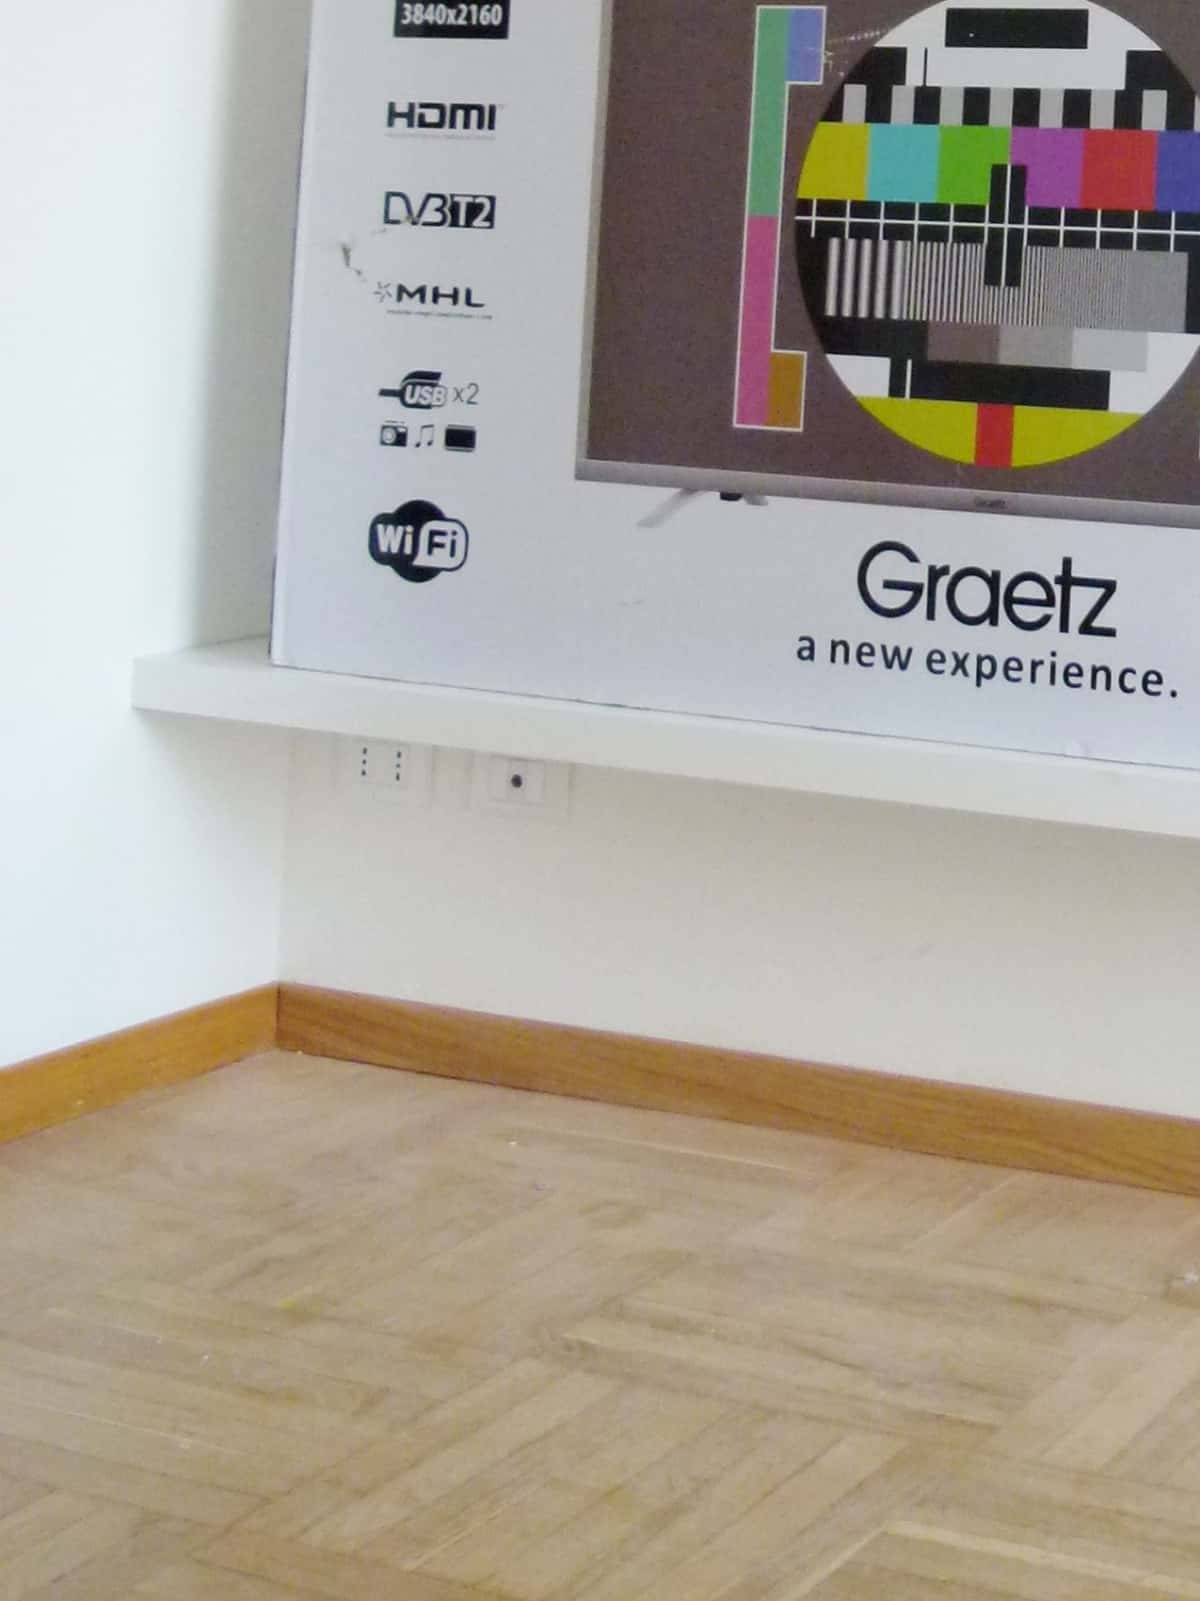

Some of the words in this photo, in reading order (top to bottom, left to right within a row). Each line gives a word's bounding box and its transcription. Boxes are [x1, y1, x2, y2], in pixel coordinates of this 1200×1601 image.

[401, 2, 503, 26] 3840x2160
[386, 101, 497, 131] HDMI
[396, 284, 486, 309] MHL
[403, 383, 448, 407] USB
[453, 382, 480, 405] x2
[857, 540, 1117, 638] Graetz
[797, 635, 816, 662] a
[829, 638, 913, 671] new
[926, 649, 1178, 699] experience.
